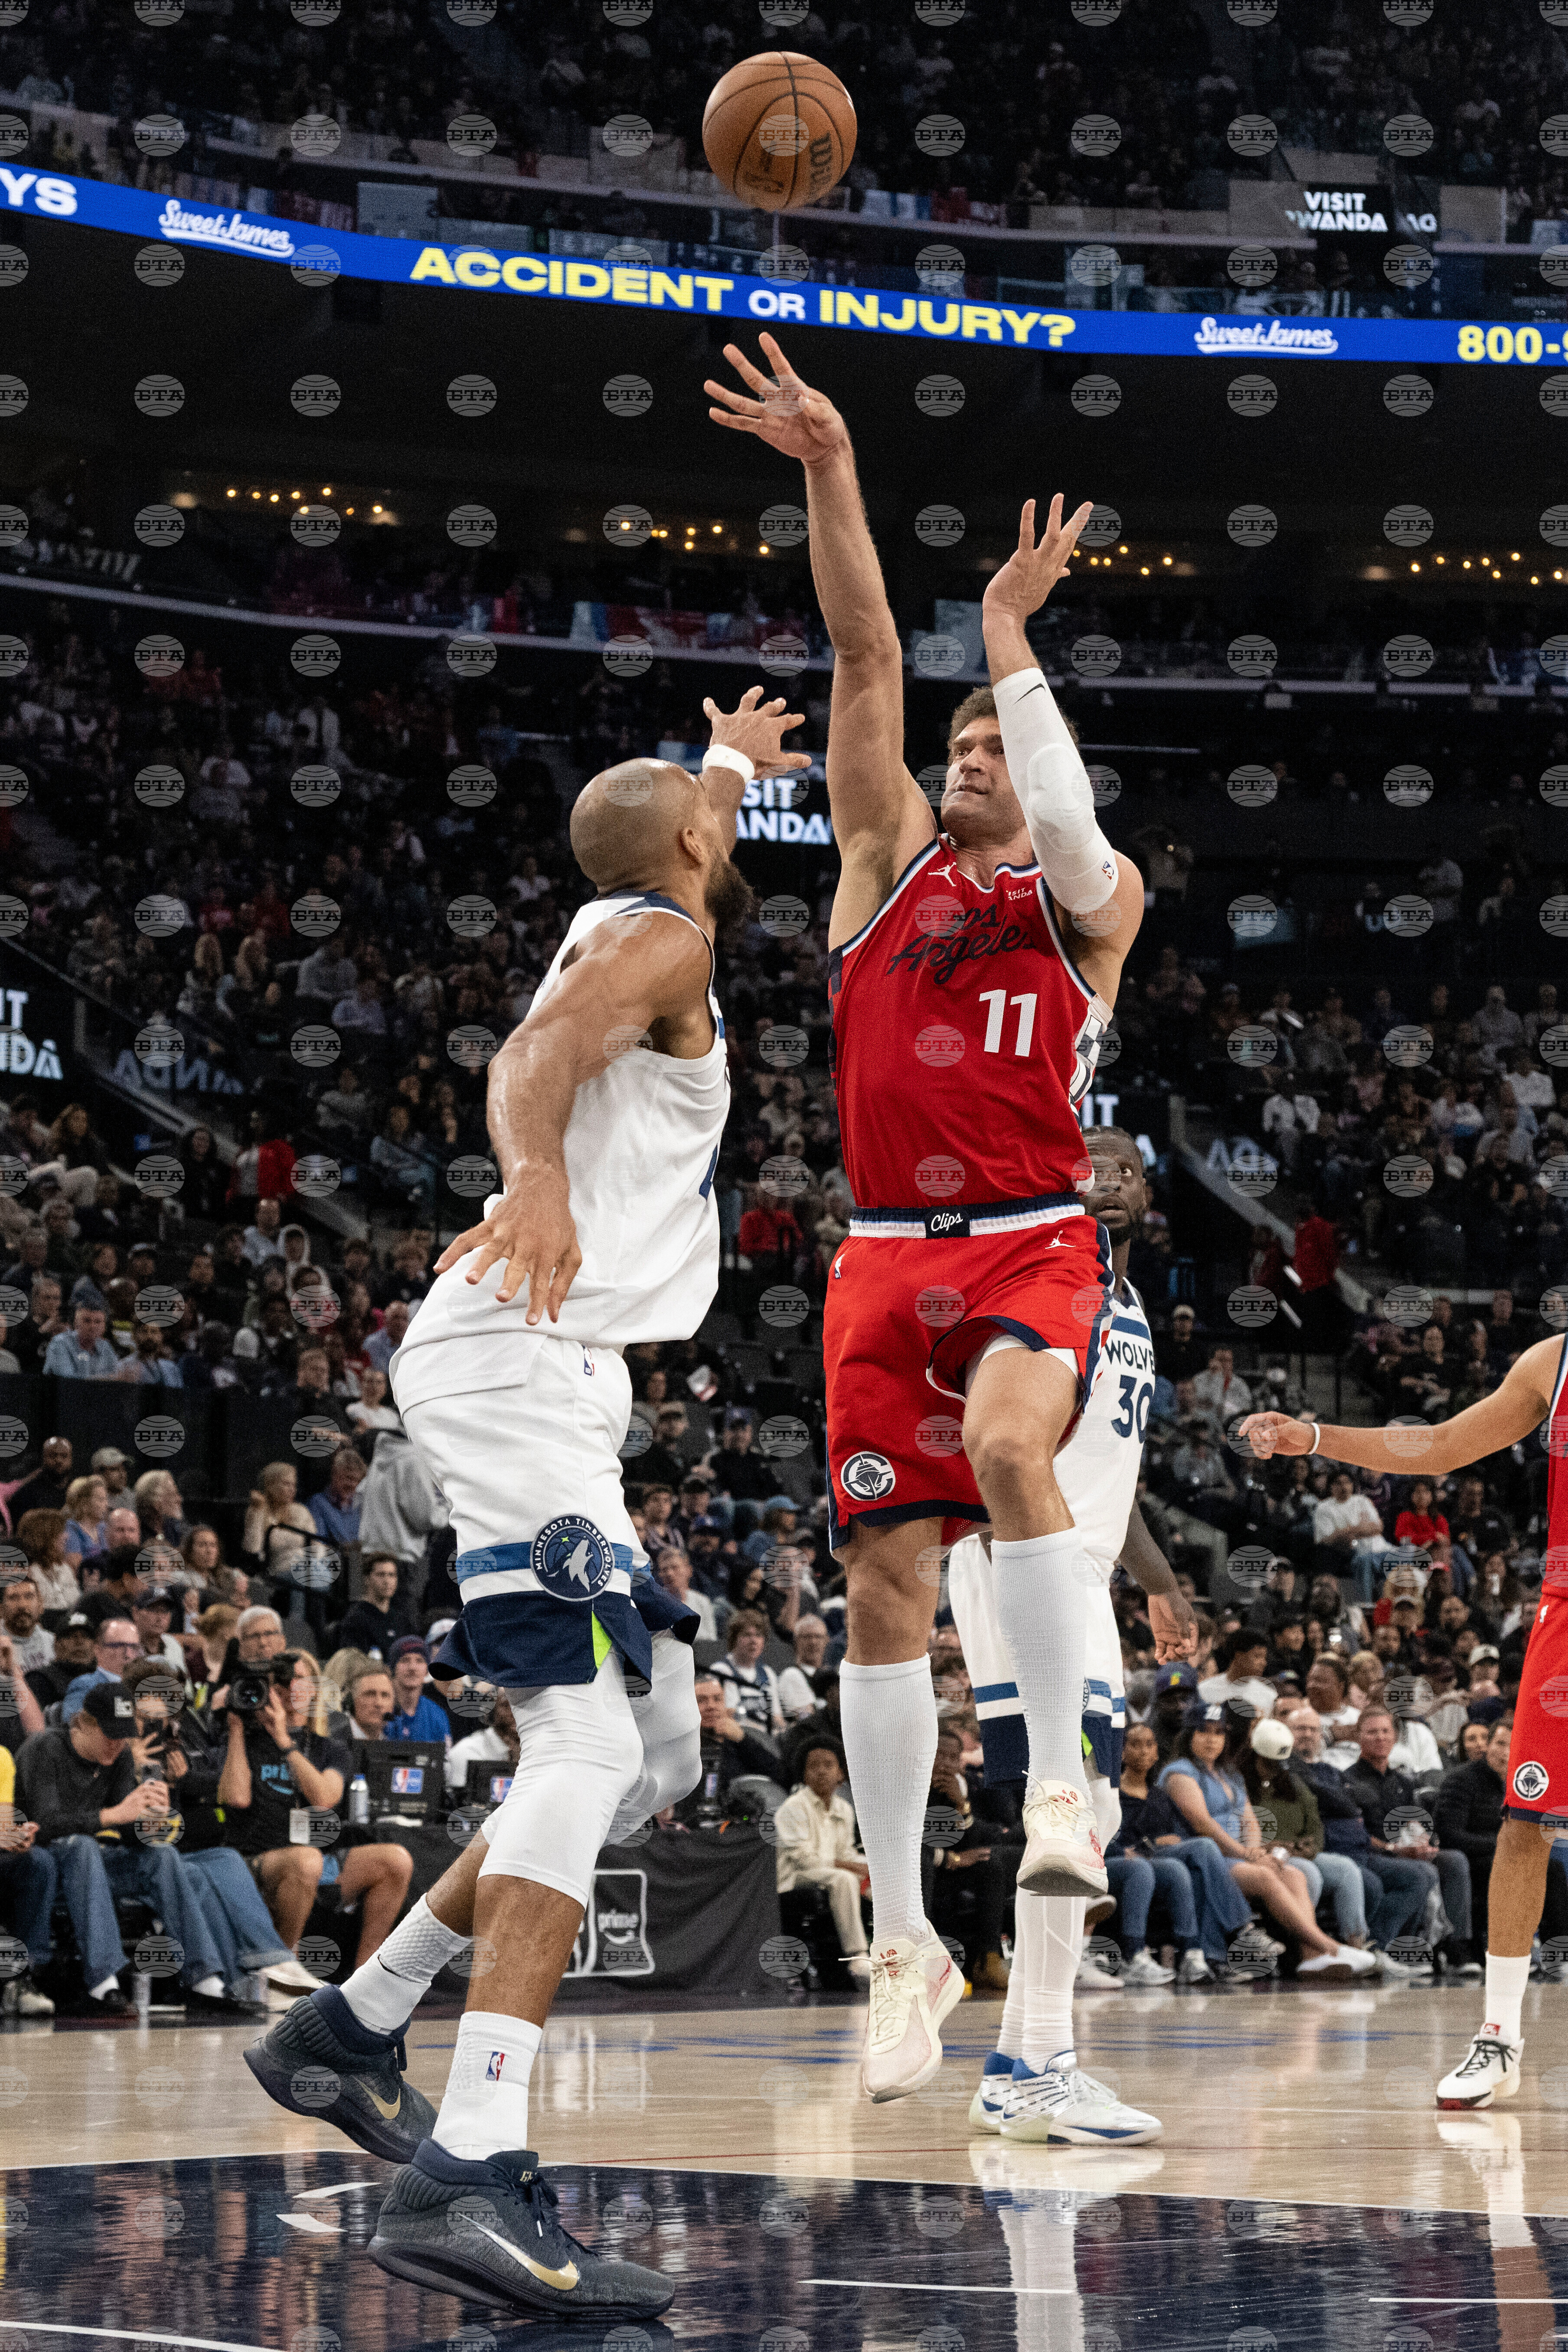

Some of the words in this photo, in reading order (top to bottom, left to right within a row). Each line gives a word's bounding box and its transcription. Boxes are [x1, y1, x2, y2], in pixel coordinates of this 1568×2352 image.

[0, 168, 78, 216] YS
[1303, 191, 1366, 212] VISIT
[409, 247, 734, 311] ACCIDENT
[748, 289, 805, 320] OR
[820, 289, 1076, 346] INJURY?
[1457, 325, 1568, 363] 800-
[1006, 887, 1026, 896] ISIT
[979, 989, 1037, 1057] 11
[931, 1213, 963, 1232] Clips
[1111, 1374, 1153, 1444] 30
[535, 1519, 570, 1570] MINNESOTA
[576, 1518, 611, 1587] TIMBERWOLVES
[261, 1764, 290, 1781] pri
